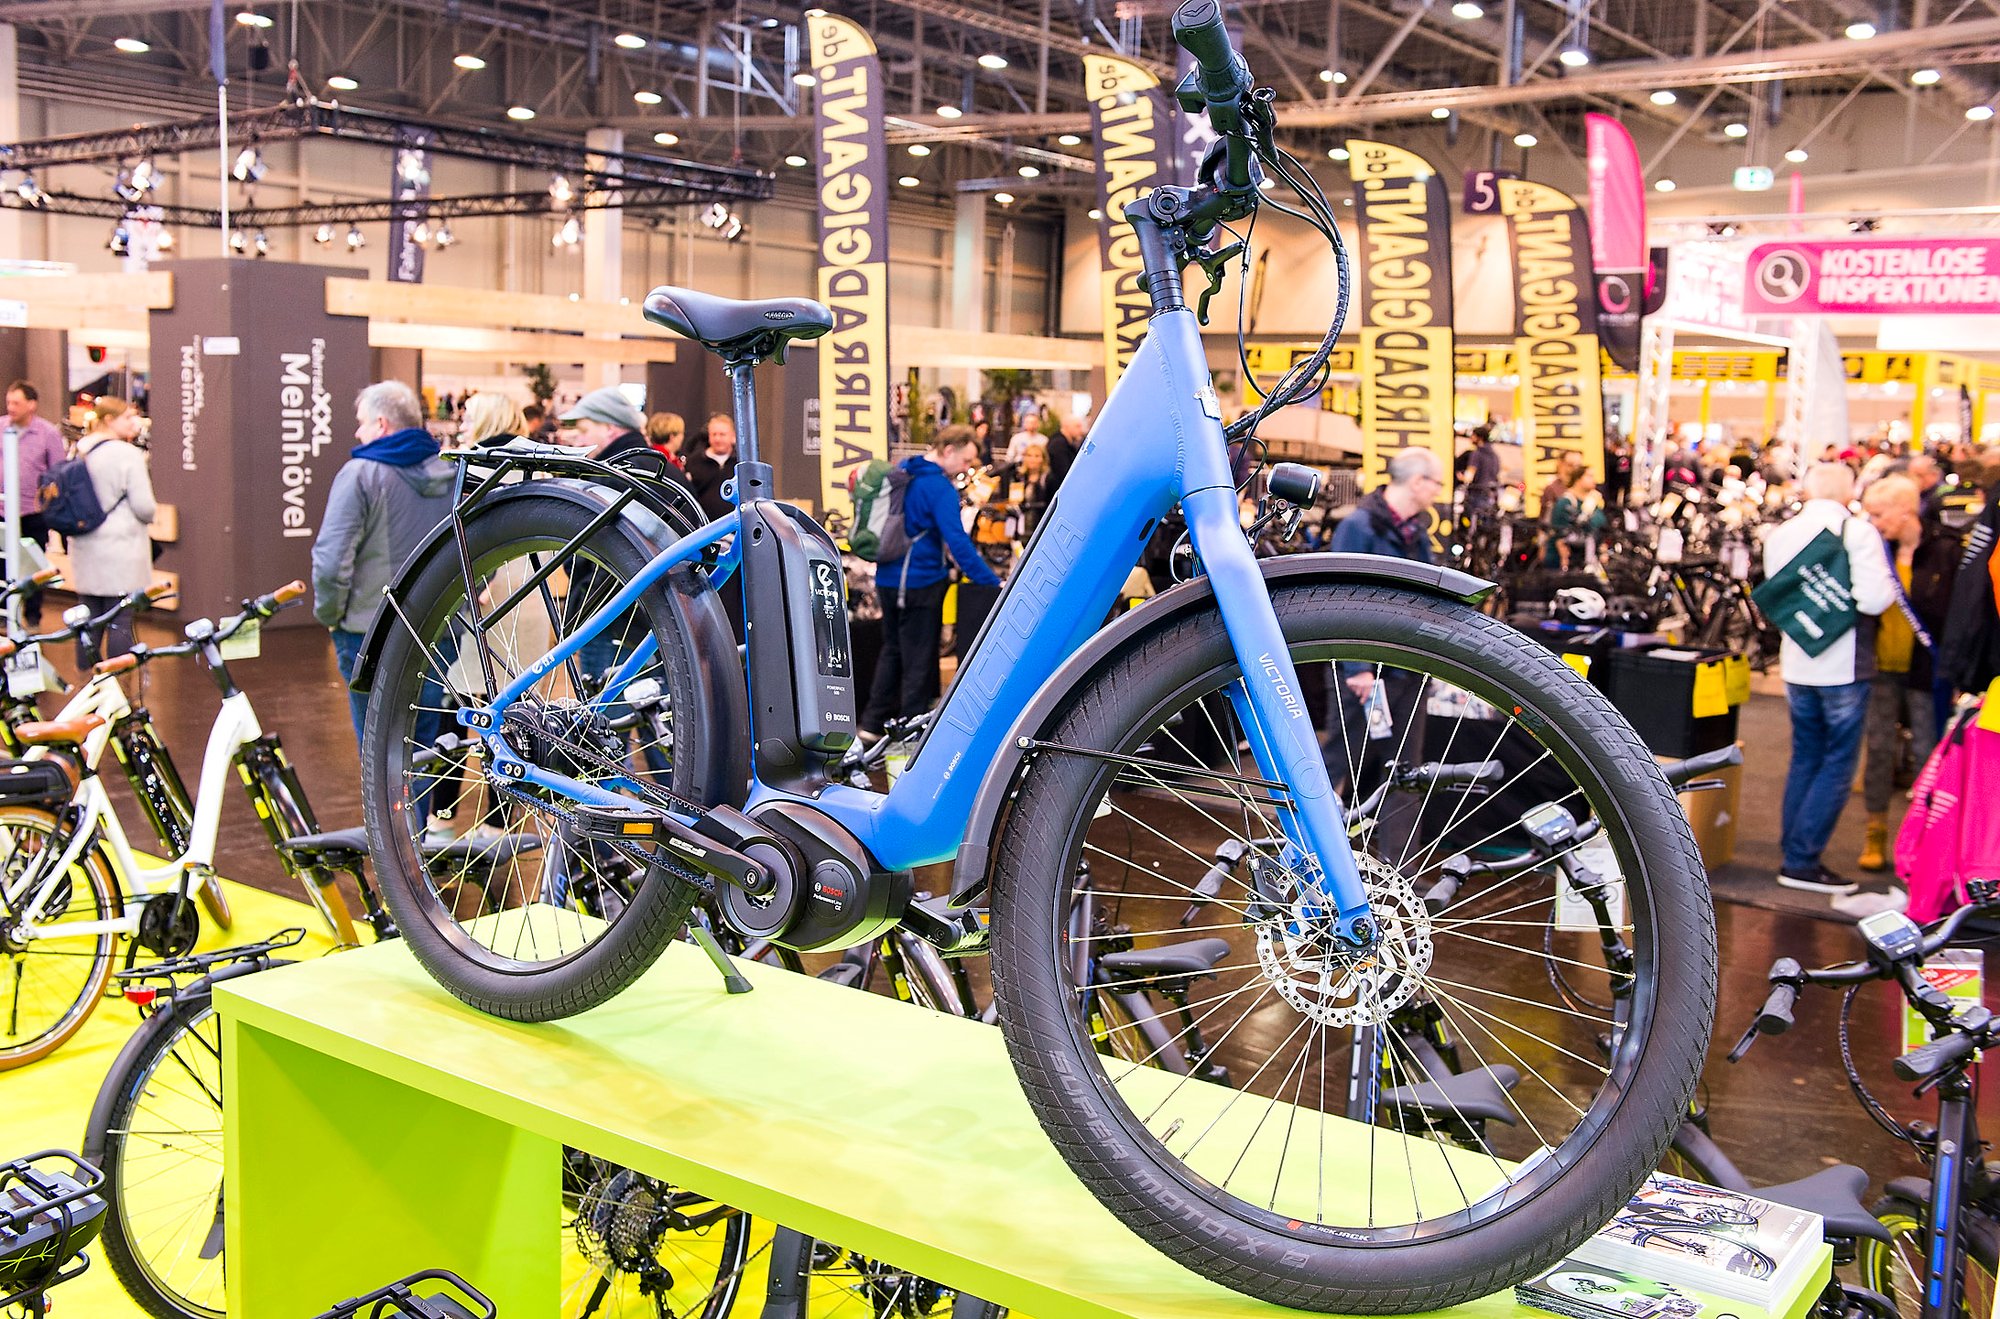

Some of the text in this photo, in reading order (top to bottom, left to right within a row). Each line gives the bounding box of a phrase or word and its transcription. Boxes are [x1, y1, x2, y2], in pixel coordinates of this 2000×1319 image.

[1471, 172, 1495, 211] 5
[1820, 247, 1988, 276] KOSTENLOSE
[181, 345, 197, 471] Meinhövel
[281, 353, 313, 537] Meinhövel
[947, 516, 1087, 737] VICTORIA
[834, 714, 850, 722] BOSCH
[1258, 652, 1303, 720] VICTORIA
[1416, 622, 1642, 783] SCHWALBE
[364, 667, 388, 850] SCHWALBE
[949, 752, 961, 772] BOSCH
[822, 885, 843, 898] BOSCH
[1048, 1050, 1267, 1257] SUPER MOTO-X
